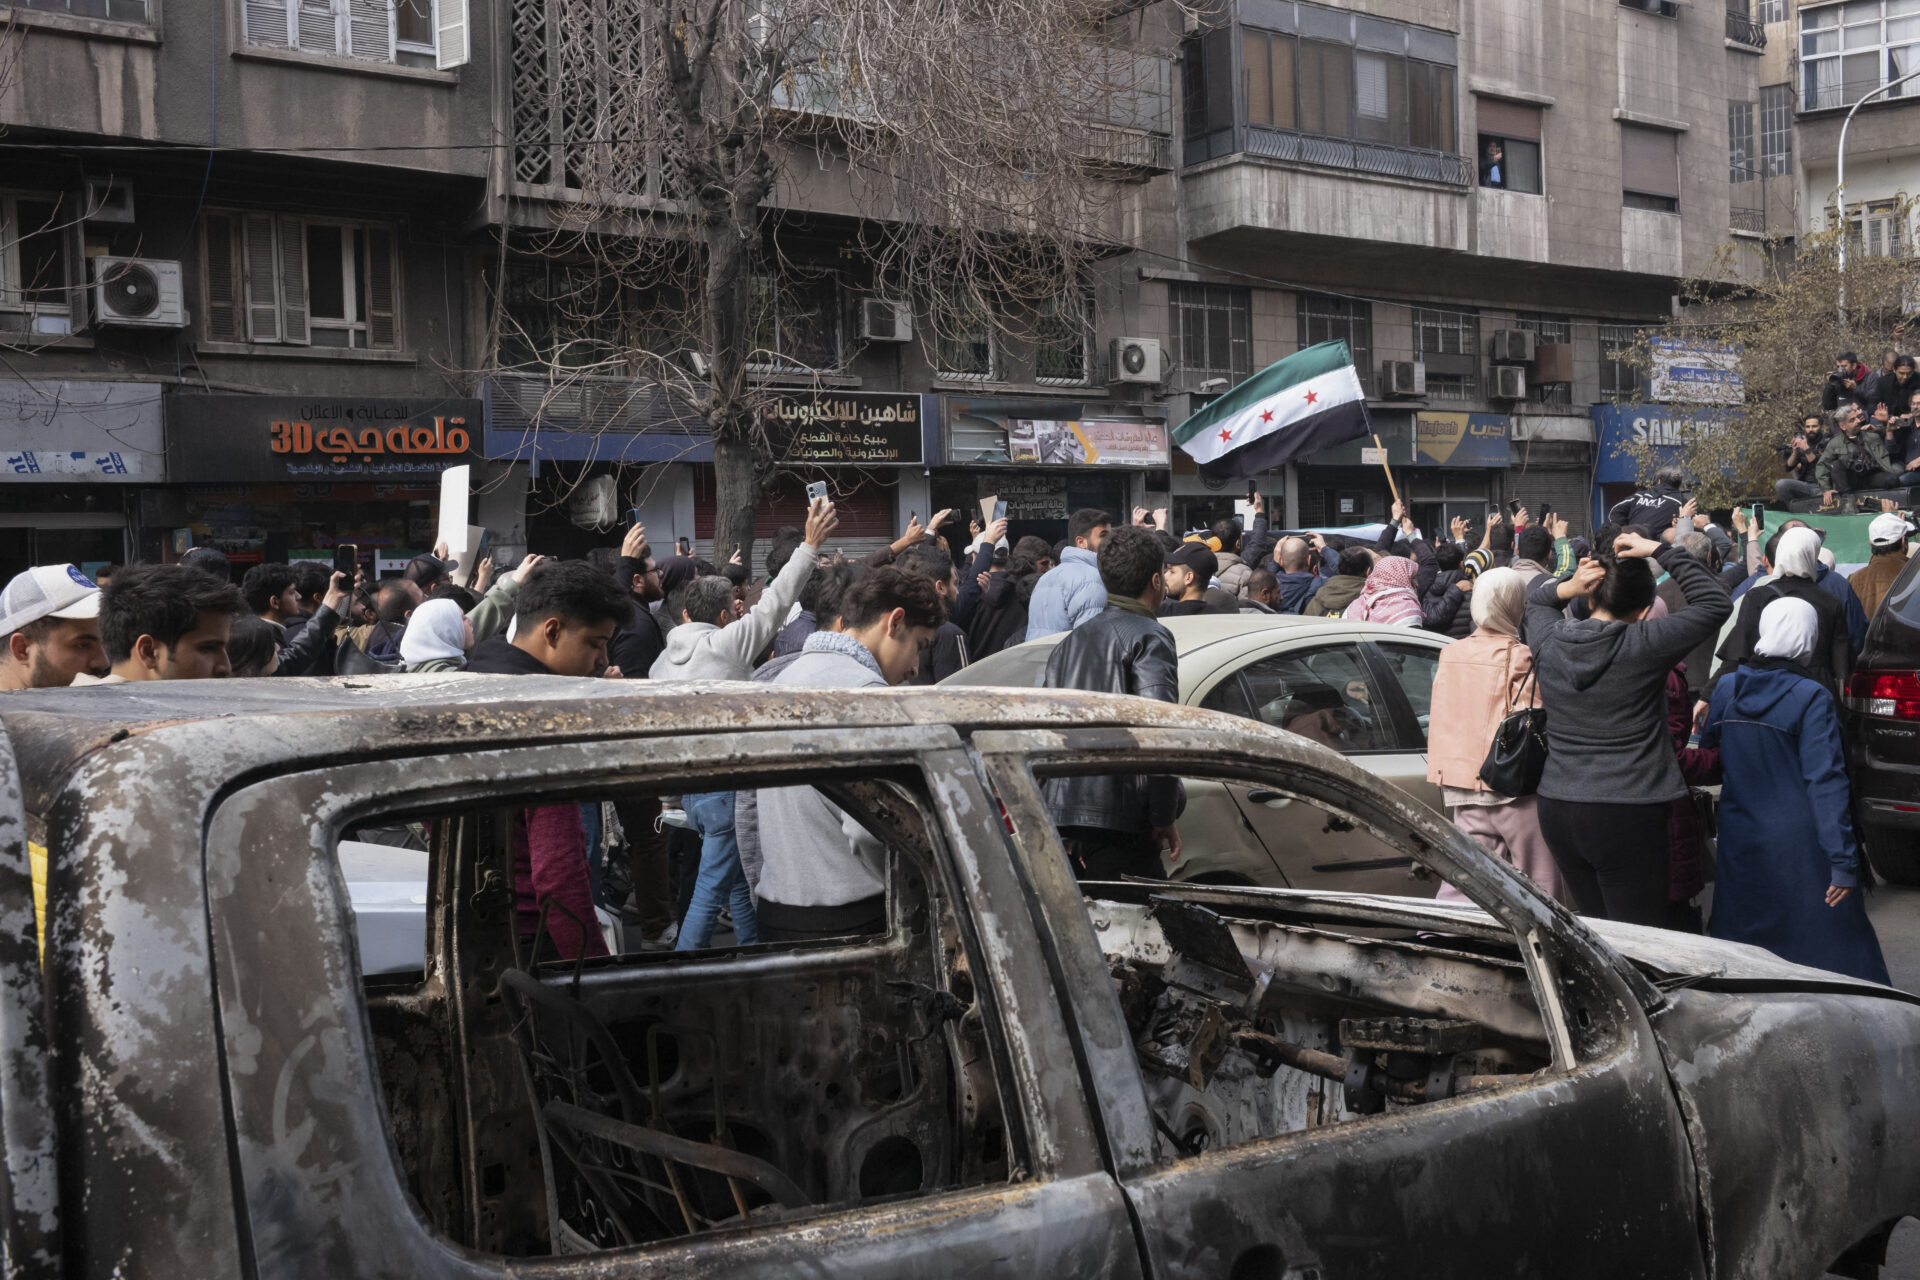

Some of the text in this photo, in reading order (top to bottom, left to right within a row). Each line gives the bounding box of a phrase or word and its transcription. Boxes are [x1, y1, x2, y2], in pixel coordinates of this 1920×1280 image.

[301, 404, 342, 421] الاعلان
[357, 404, 408, 420] للدعاية
[763, 399, 916, 428] شاهين للإلكترونيات
[271, 420, 313, 453] 3D
[1417, 421, 1458, 437] Najeeb
[1470, 421, 1506, 440] نجيب
[316, 427, 385, 463] جي
[800, 432, 888, 445] مبيع كافة القطع
[789, 447, 843, 459] والصوتيات
